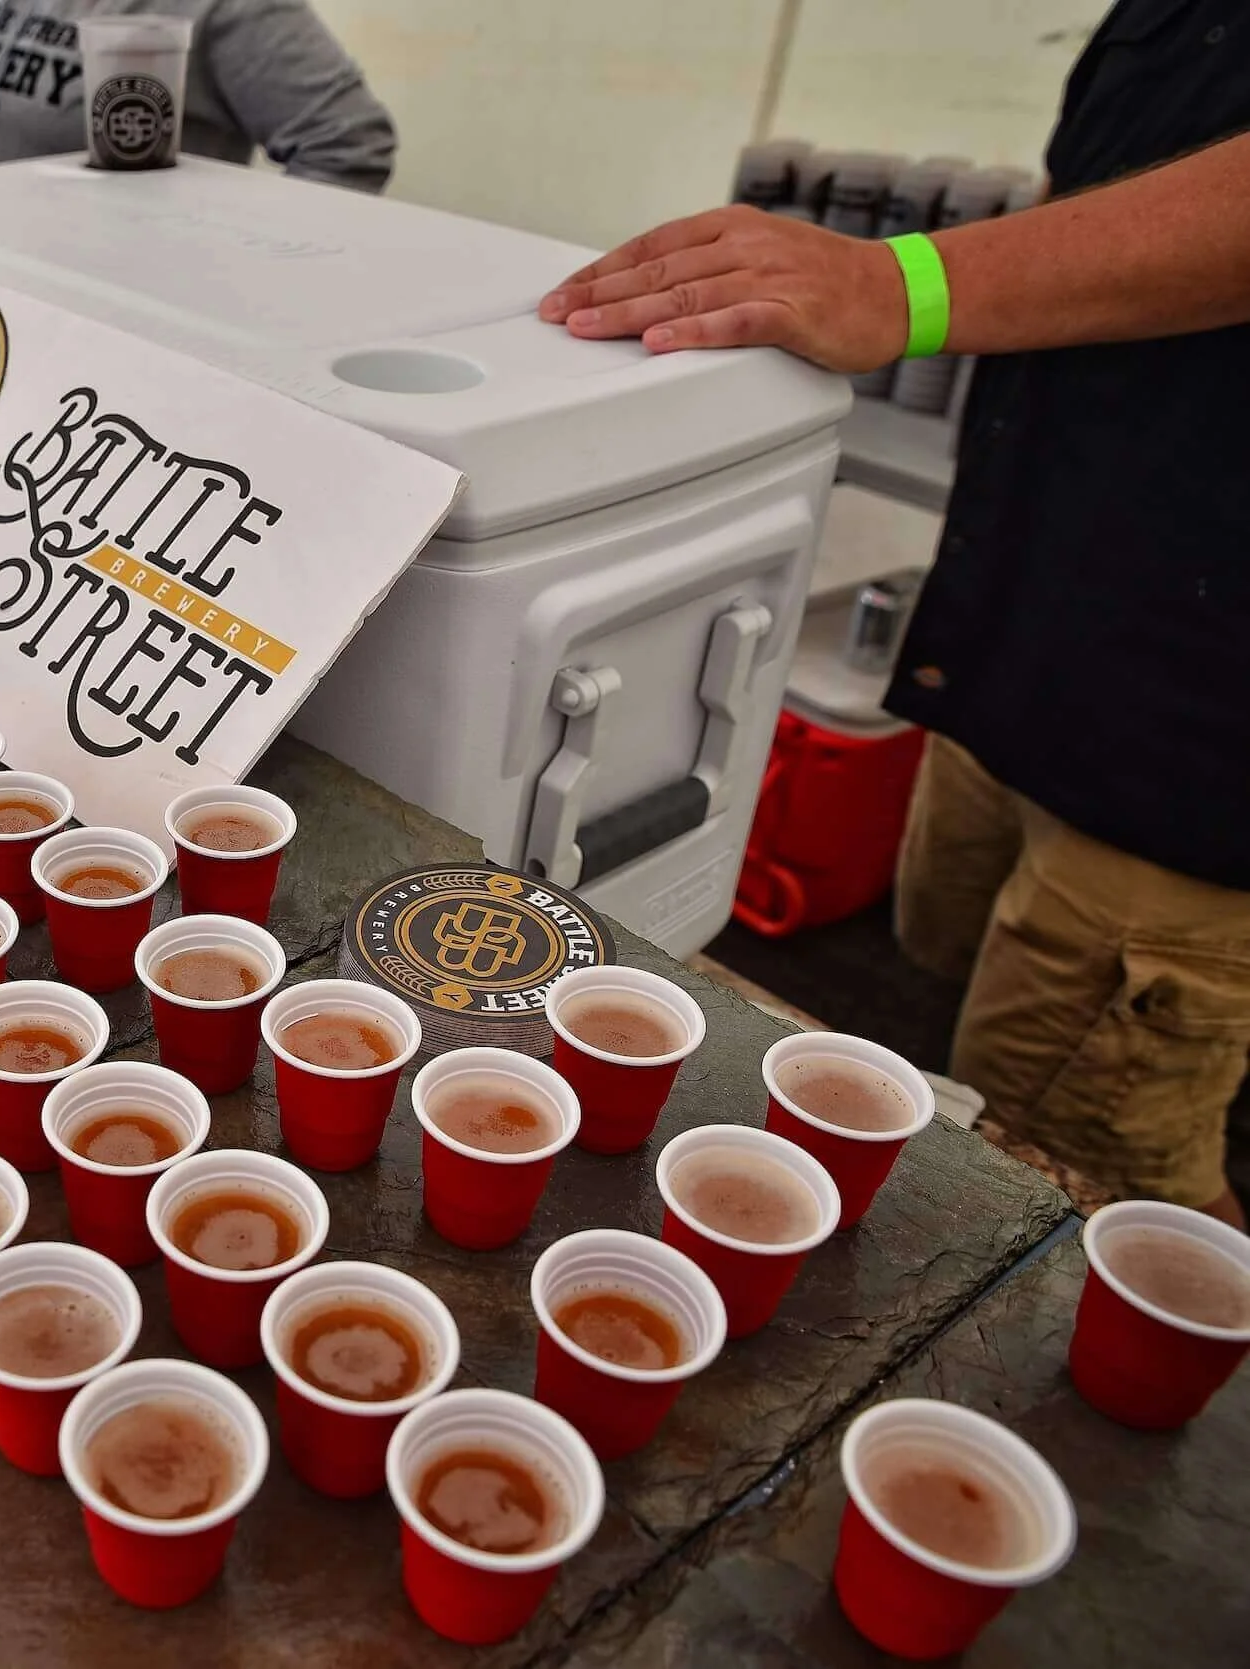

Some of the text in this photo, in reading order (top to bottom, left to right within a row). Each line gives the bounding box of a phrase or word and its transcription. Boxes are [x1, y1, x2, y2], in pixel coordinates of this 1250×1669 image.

[109, 556, 270, 655] BREWERY
[372, 885, 421, 952] BREWERY
[524, 889, 594, 964] BATTLE
